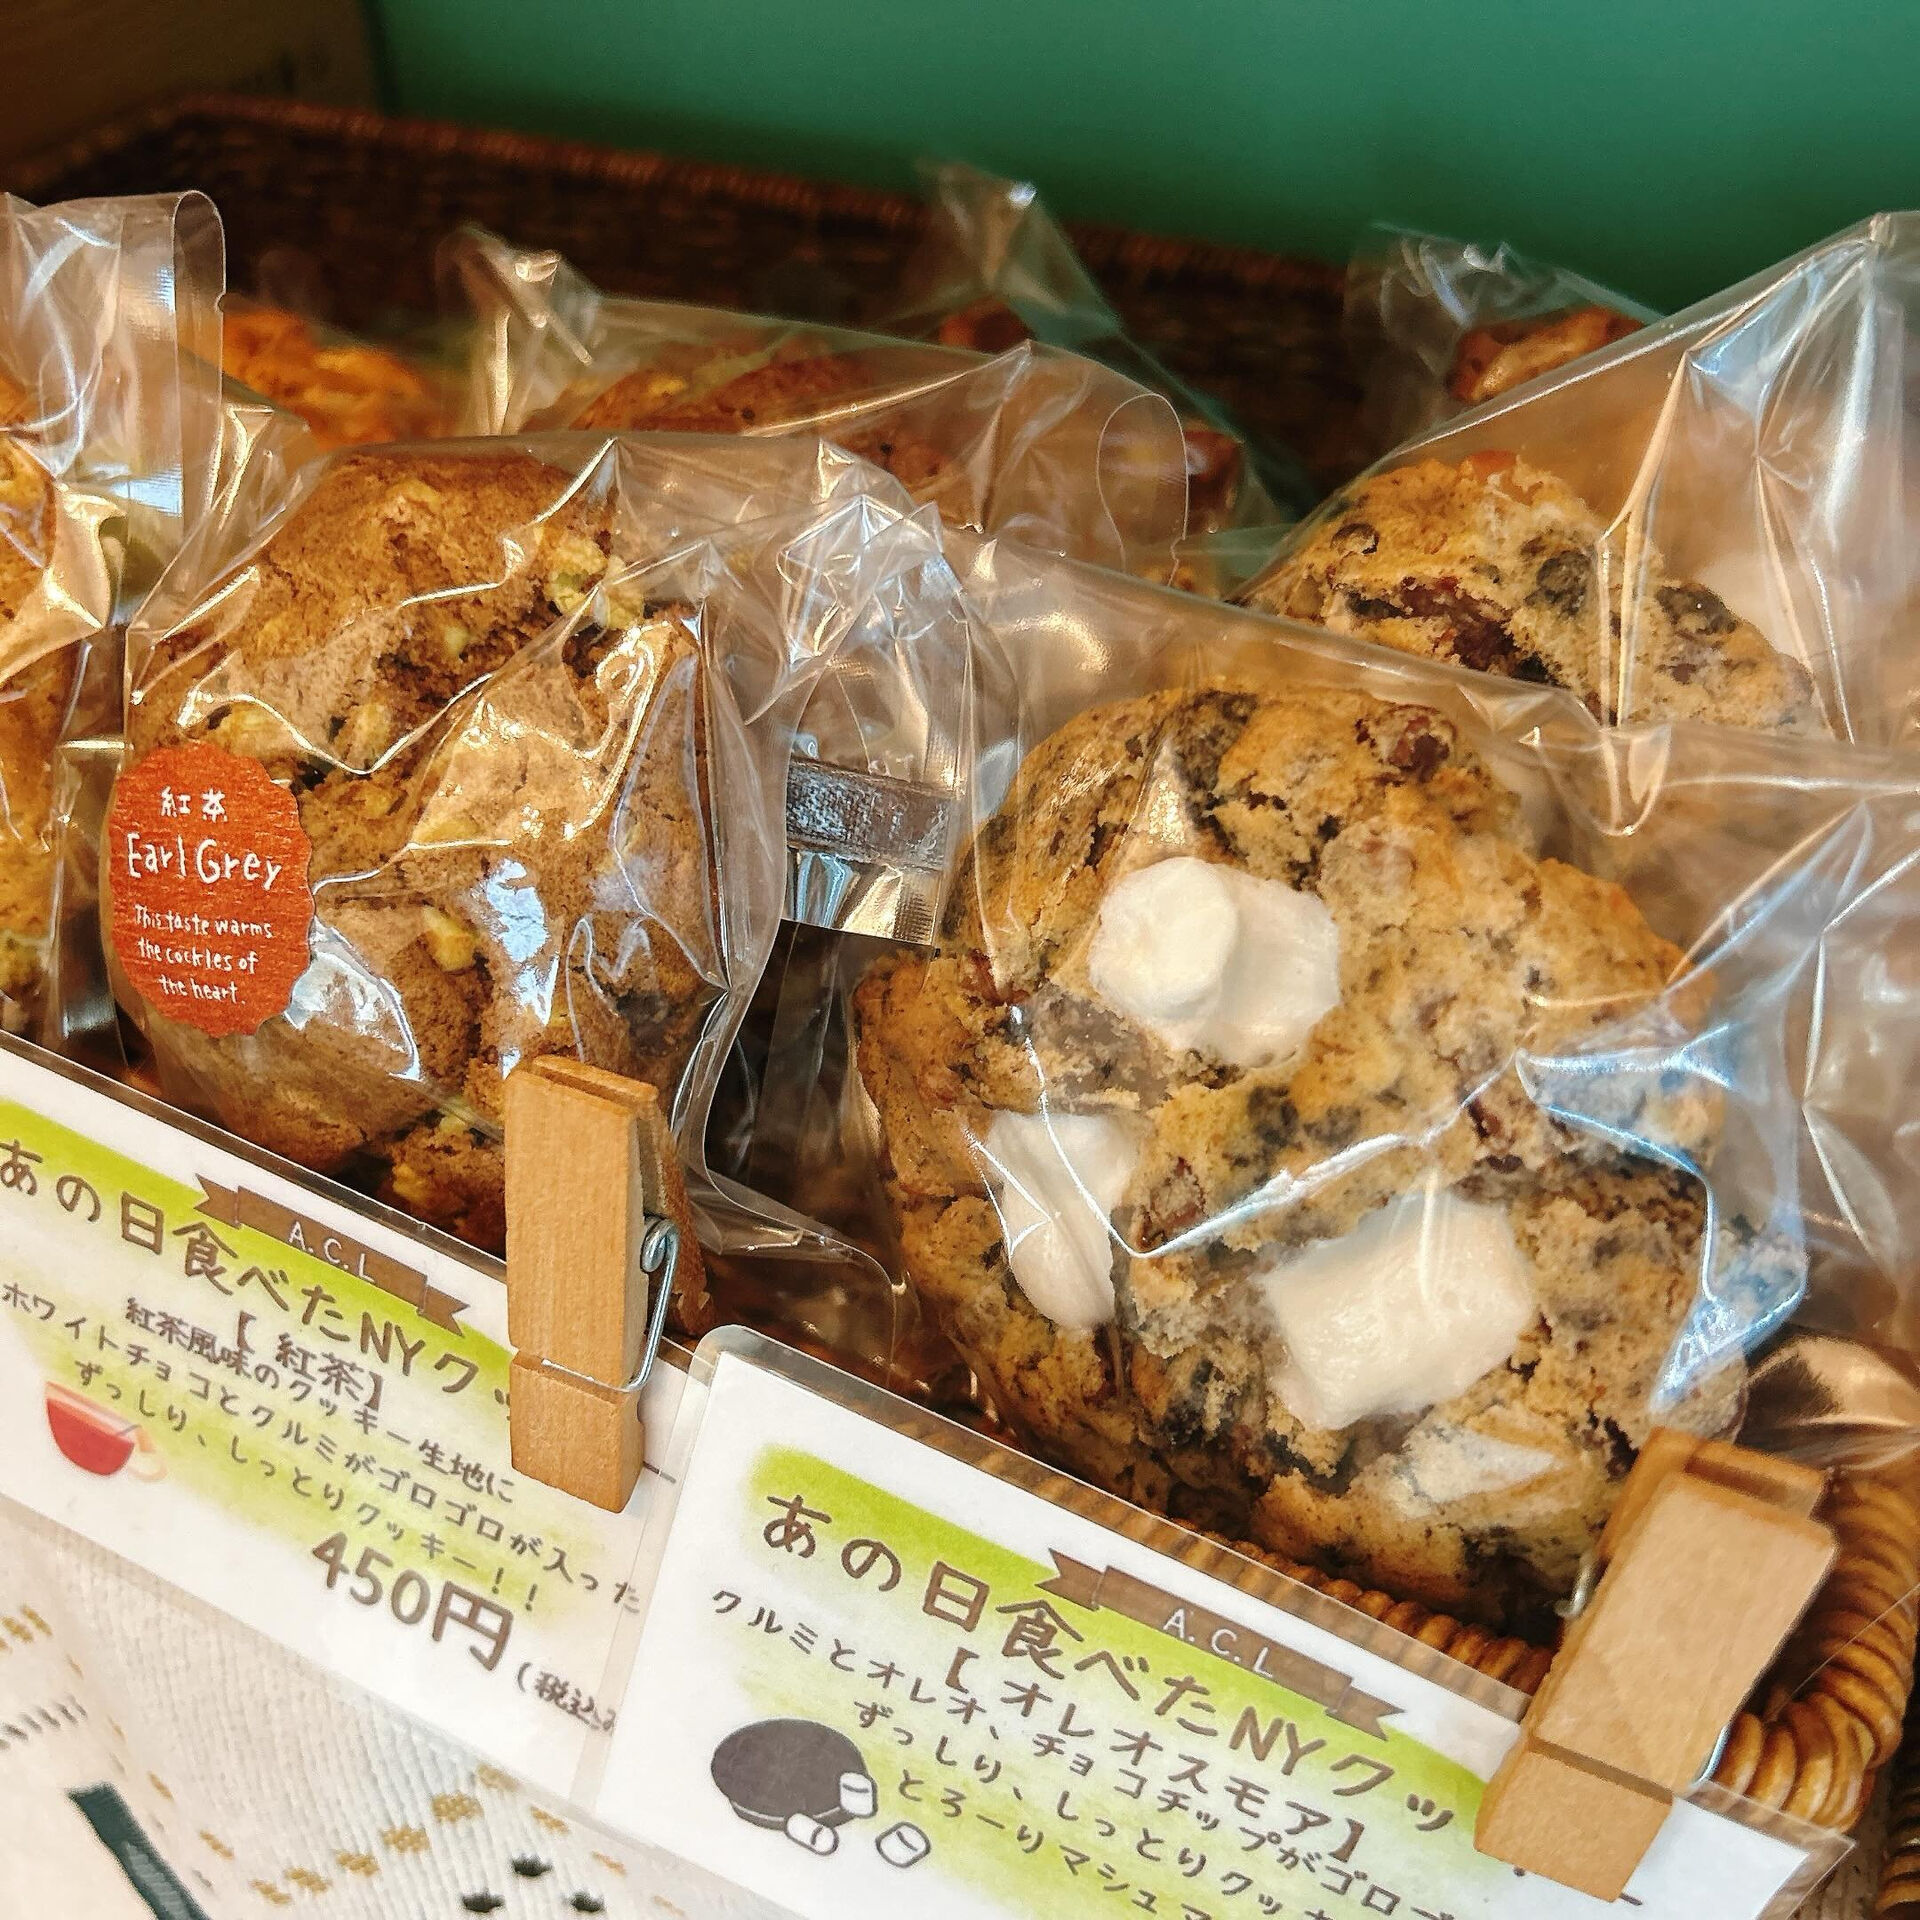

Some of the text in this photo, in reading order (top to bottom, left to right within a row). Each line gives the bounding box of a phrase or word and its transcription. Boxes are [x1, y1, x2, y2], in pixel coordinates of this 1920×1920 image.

[159, 785, 229, 823] 紅茶
[126, 831, 284, 891] Earl Grey
[134, 903, 273, 939] This taste warms
[137, 937, 259, 974] the cockles of
[159, 973, 247, 1005] the heart.
[287, 1220, 376, 1284] A.C.L
[125, 1296, 515, 1503] 紅茶風味のクッキー生地に
[1, 1282, 641, 1614] ホワイトチョコとクルミがゴロゴロが入った
[312, 1531, 515, 1671] 450円
[1162, 1607, 1274, 1678] A.C.L
[762, 1494, 1641, 1906] あの日食べたNYクッ
